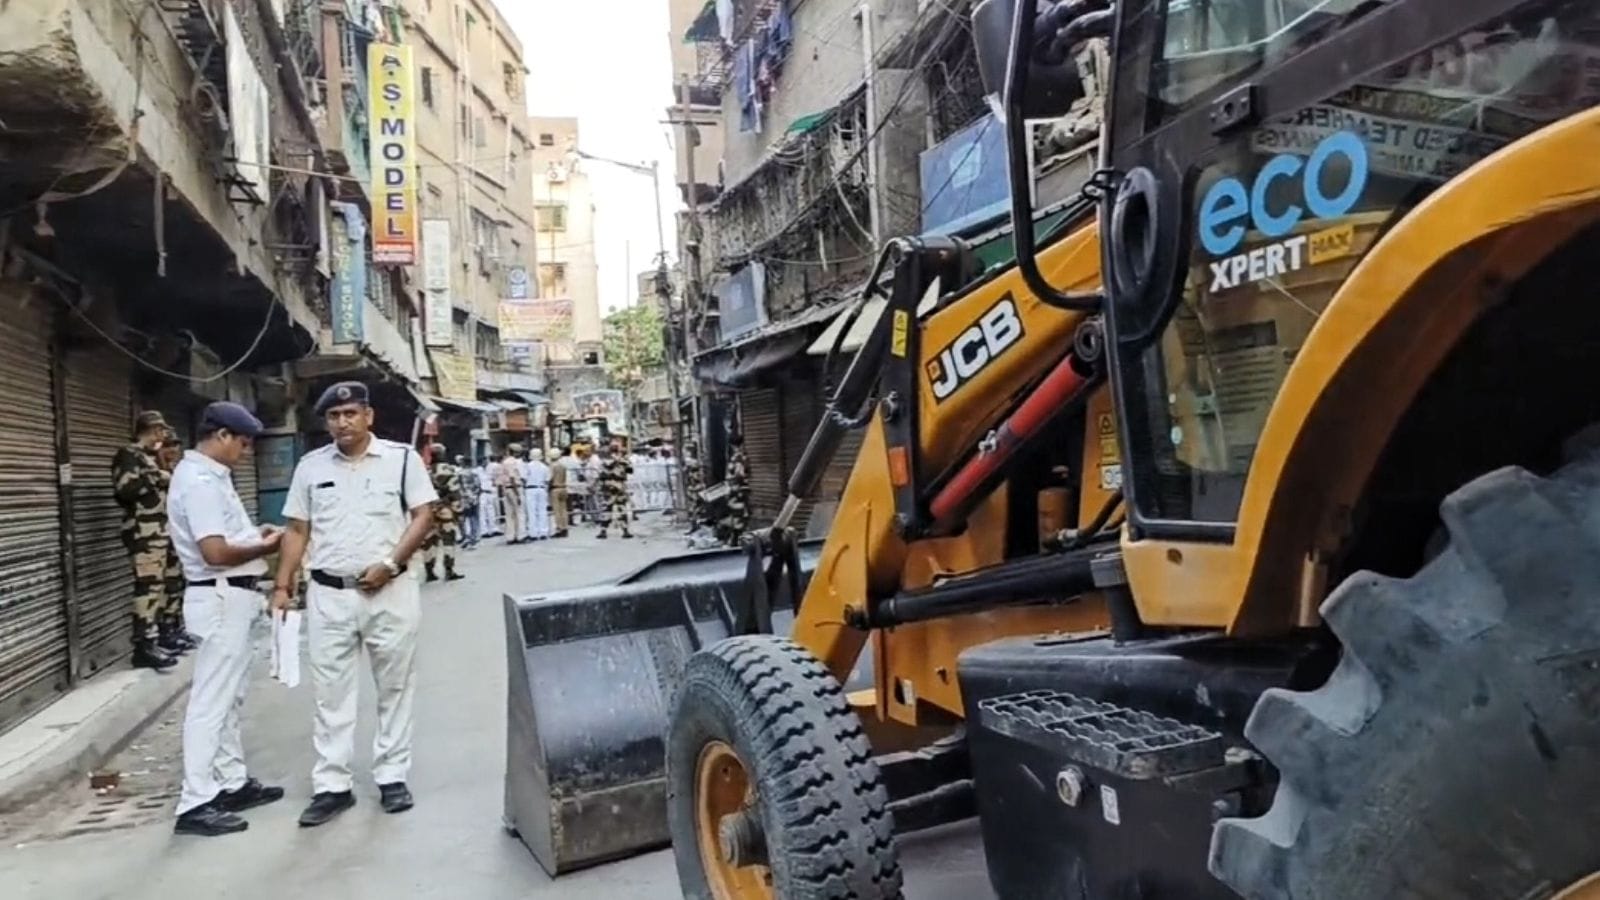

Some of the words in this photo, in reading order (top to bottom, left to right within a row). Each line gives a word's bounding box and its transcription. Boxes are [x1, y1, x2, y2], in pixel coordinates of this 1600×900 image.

[1199, 131, 1368, 255] eco
[1209, 236, 1306, 292] XPERT
[1312, 228, 1352, 257] MAX
[929, 298, 1022, 400] JCB
